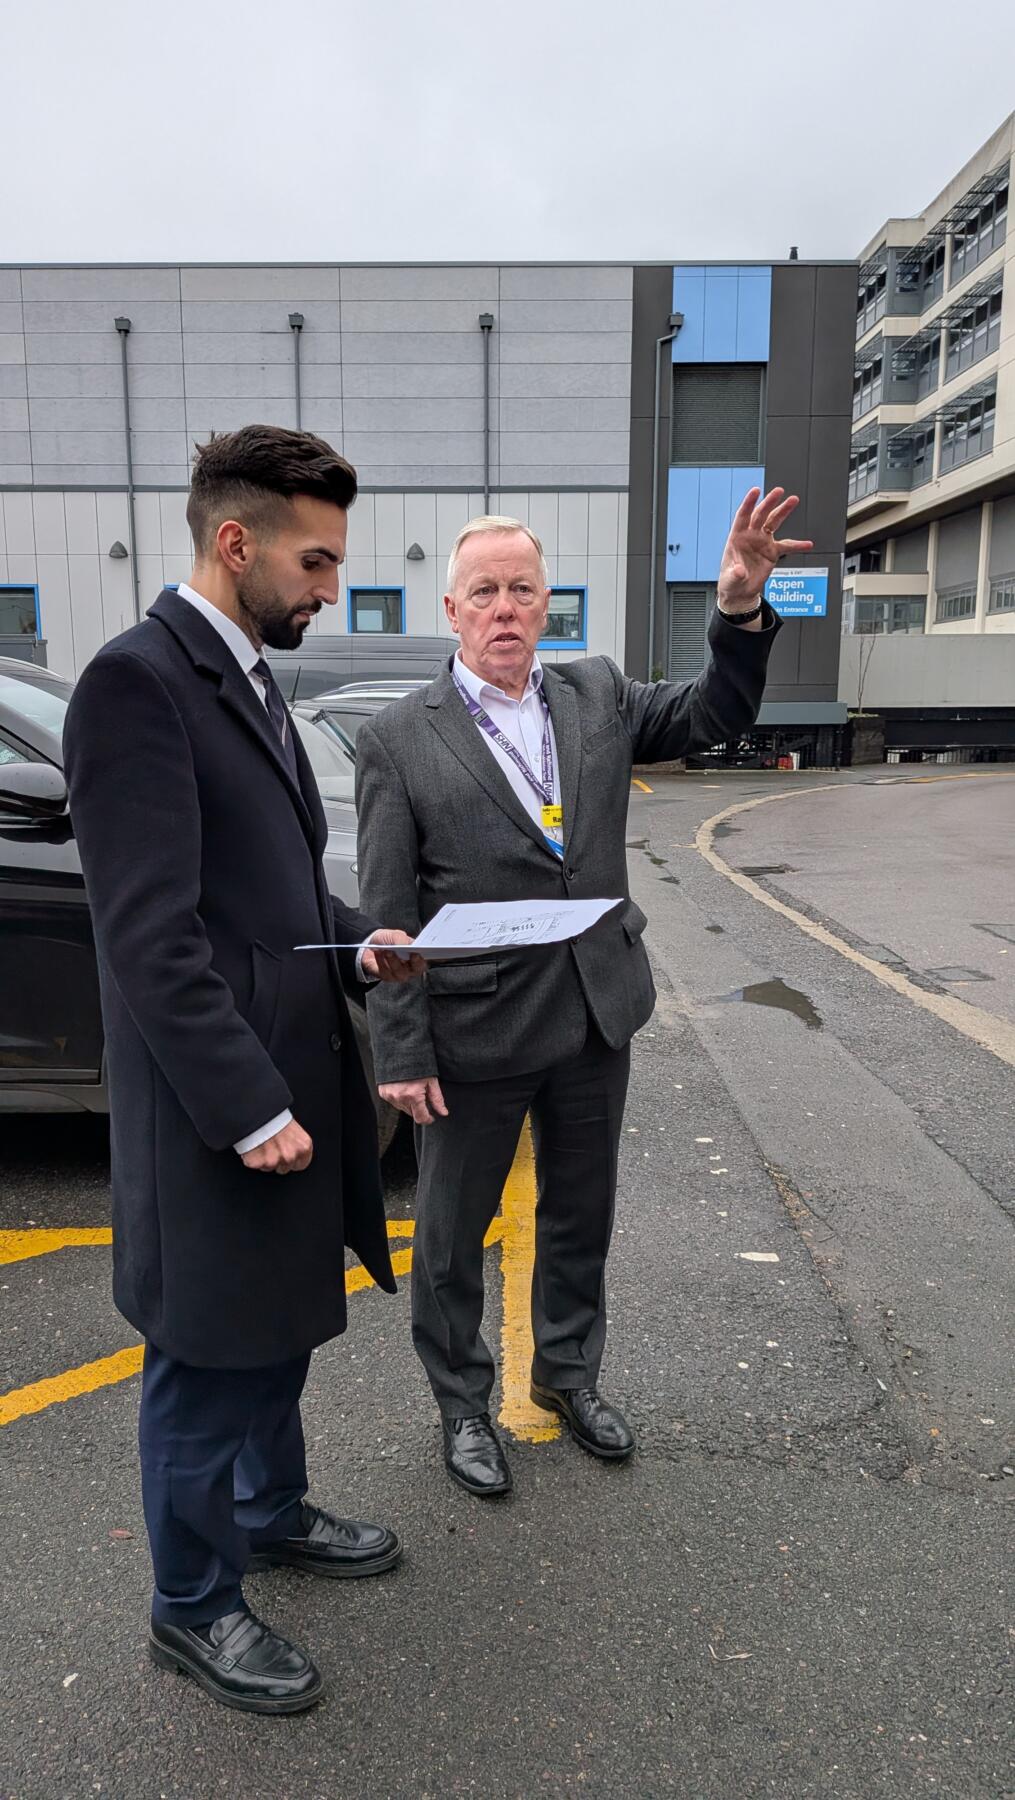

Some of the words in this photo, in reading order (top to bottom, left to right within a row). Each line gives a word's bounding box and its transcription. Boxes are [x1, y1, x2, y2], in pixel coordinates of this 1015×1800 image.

[769, 579, 805, 591] Aspen
[769, 591, 814, 604] Building
[494, 733, 513, 752] NHS
